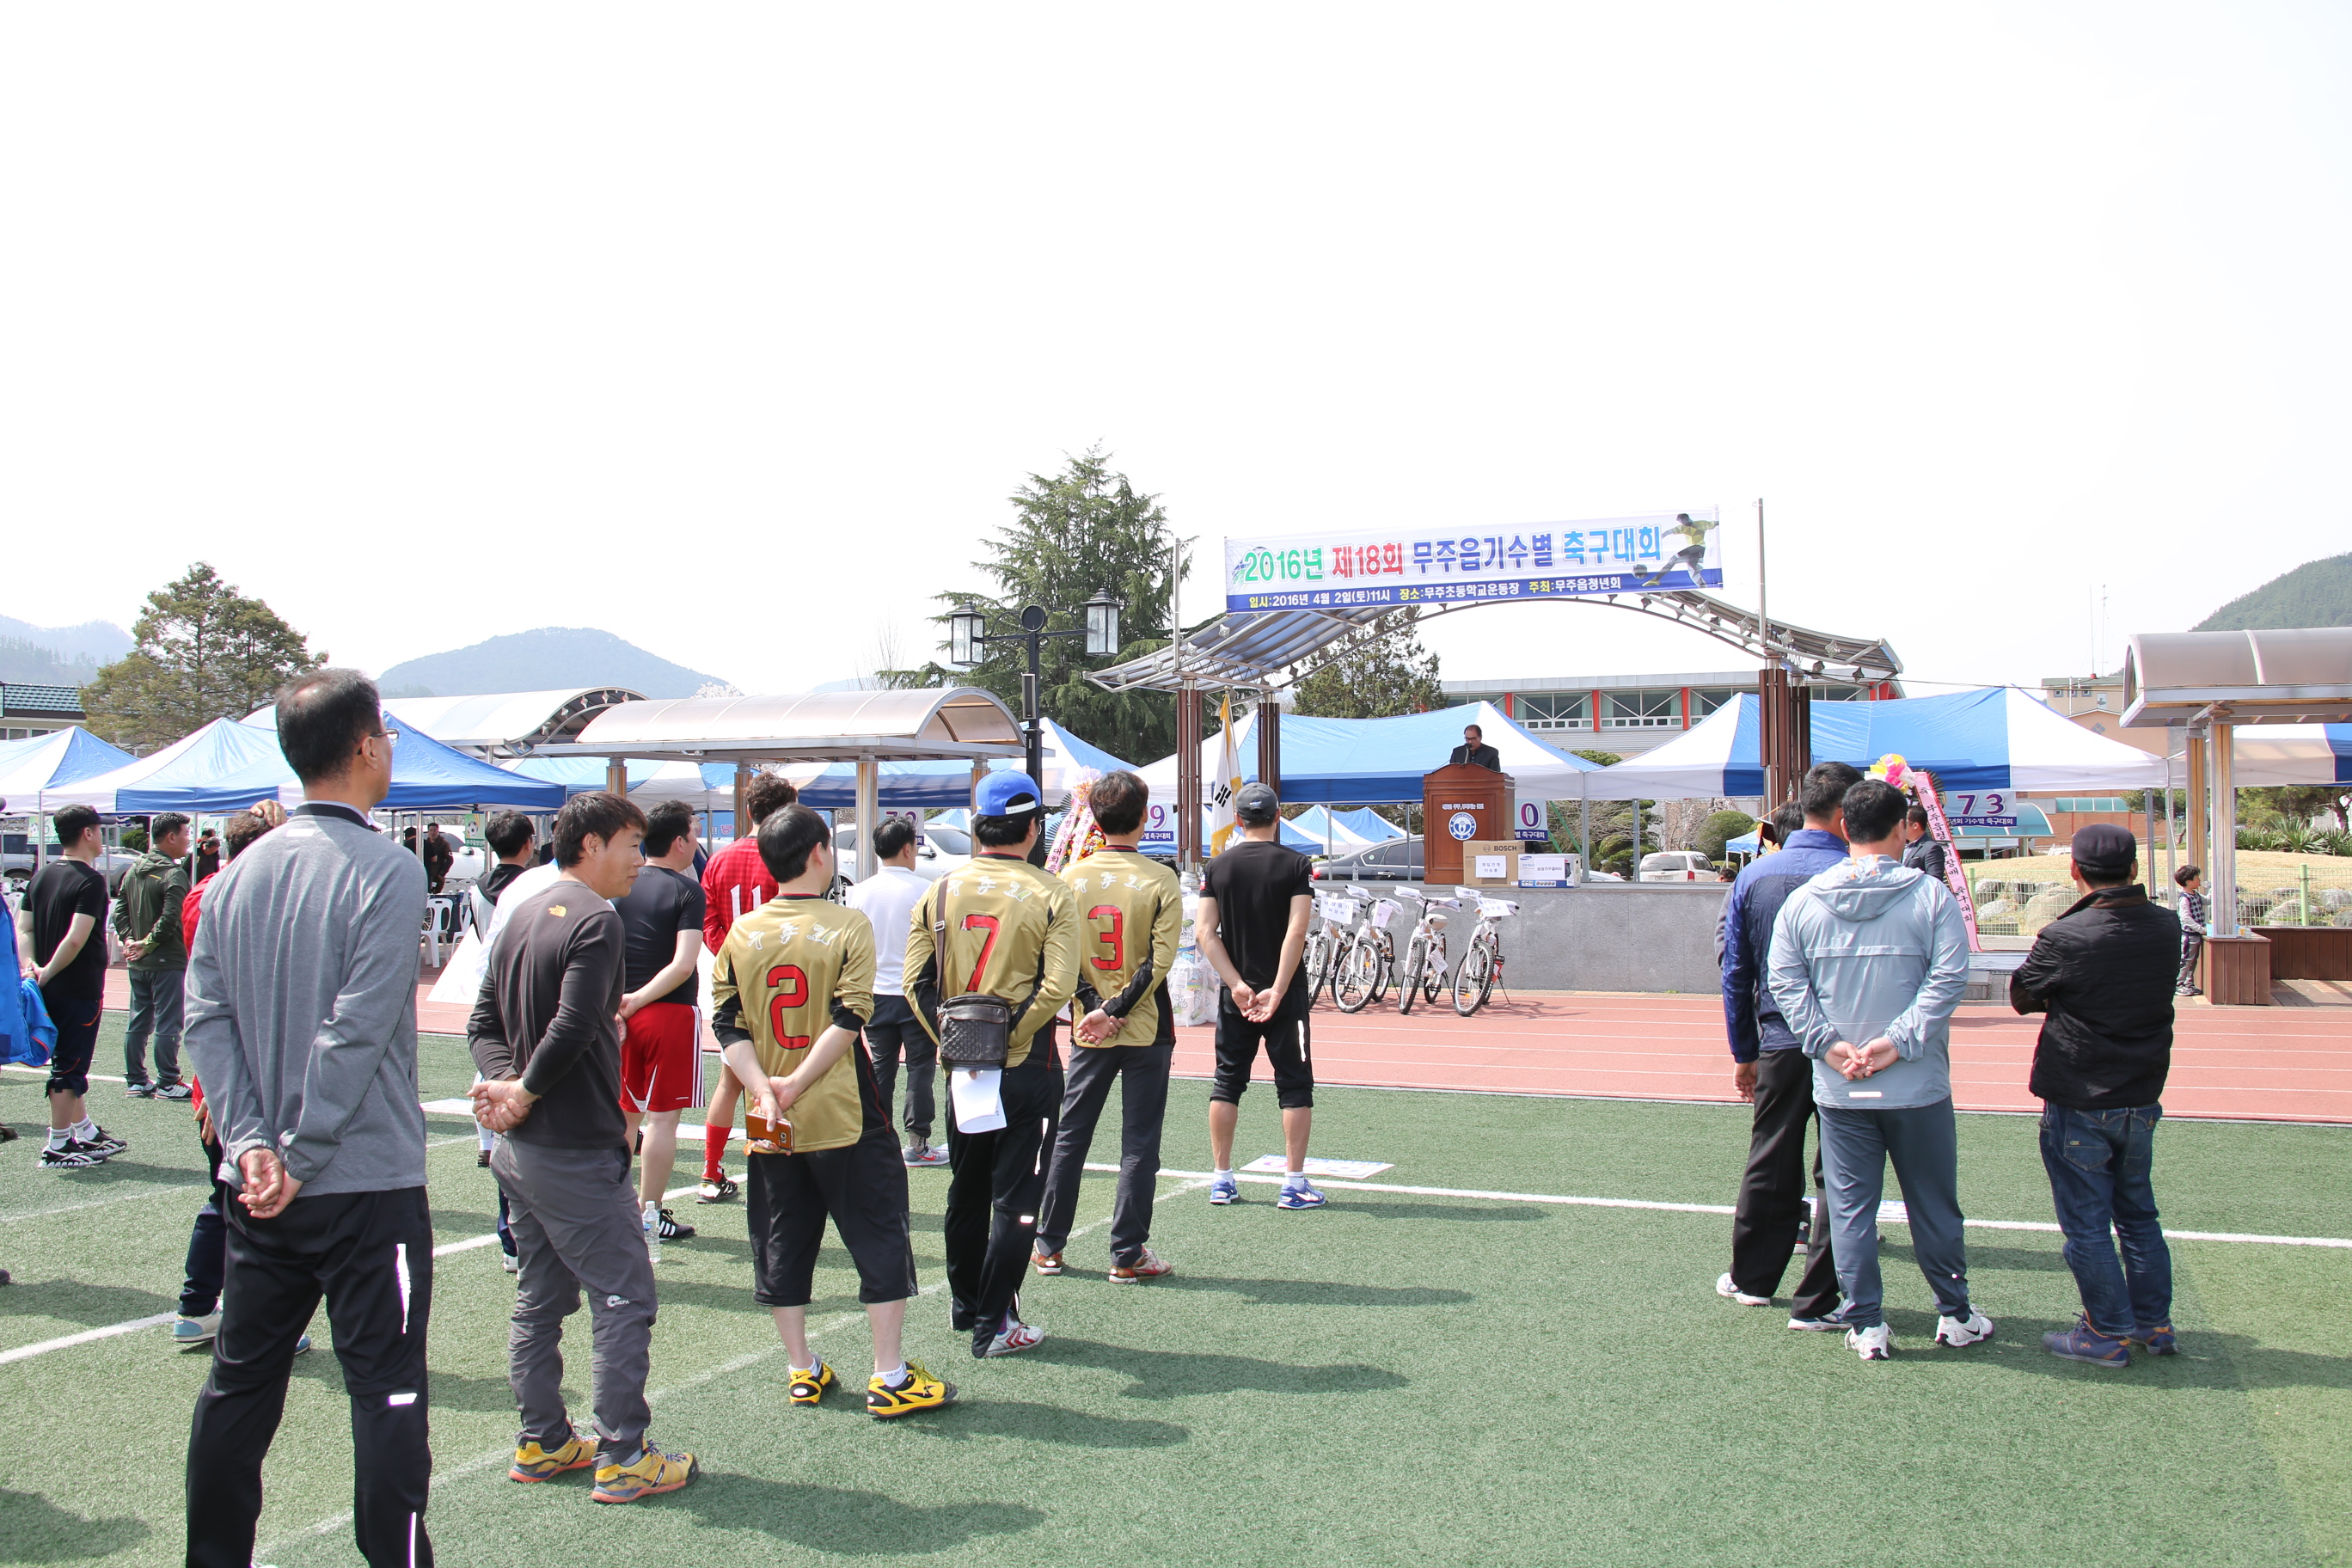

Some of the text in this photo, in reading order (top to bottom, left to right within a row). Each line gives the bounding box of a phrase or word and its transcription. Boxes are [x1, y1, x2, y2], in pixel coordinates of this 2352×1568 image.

[1244, 525, 1661, 582] 2016년 제18회 무주읍기수별 축구대회
[1313, 592, 1331, 605] 4월
[1333, 588, 1391, 604] 2일(토)11시
[1522, 830, 1545, 839] 축구대회
[959, 914, 1000, 992] 7
[1087, 904, 1124, 971] 3
[767, 964, 810, 1050] 2
